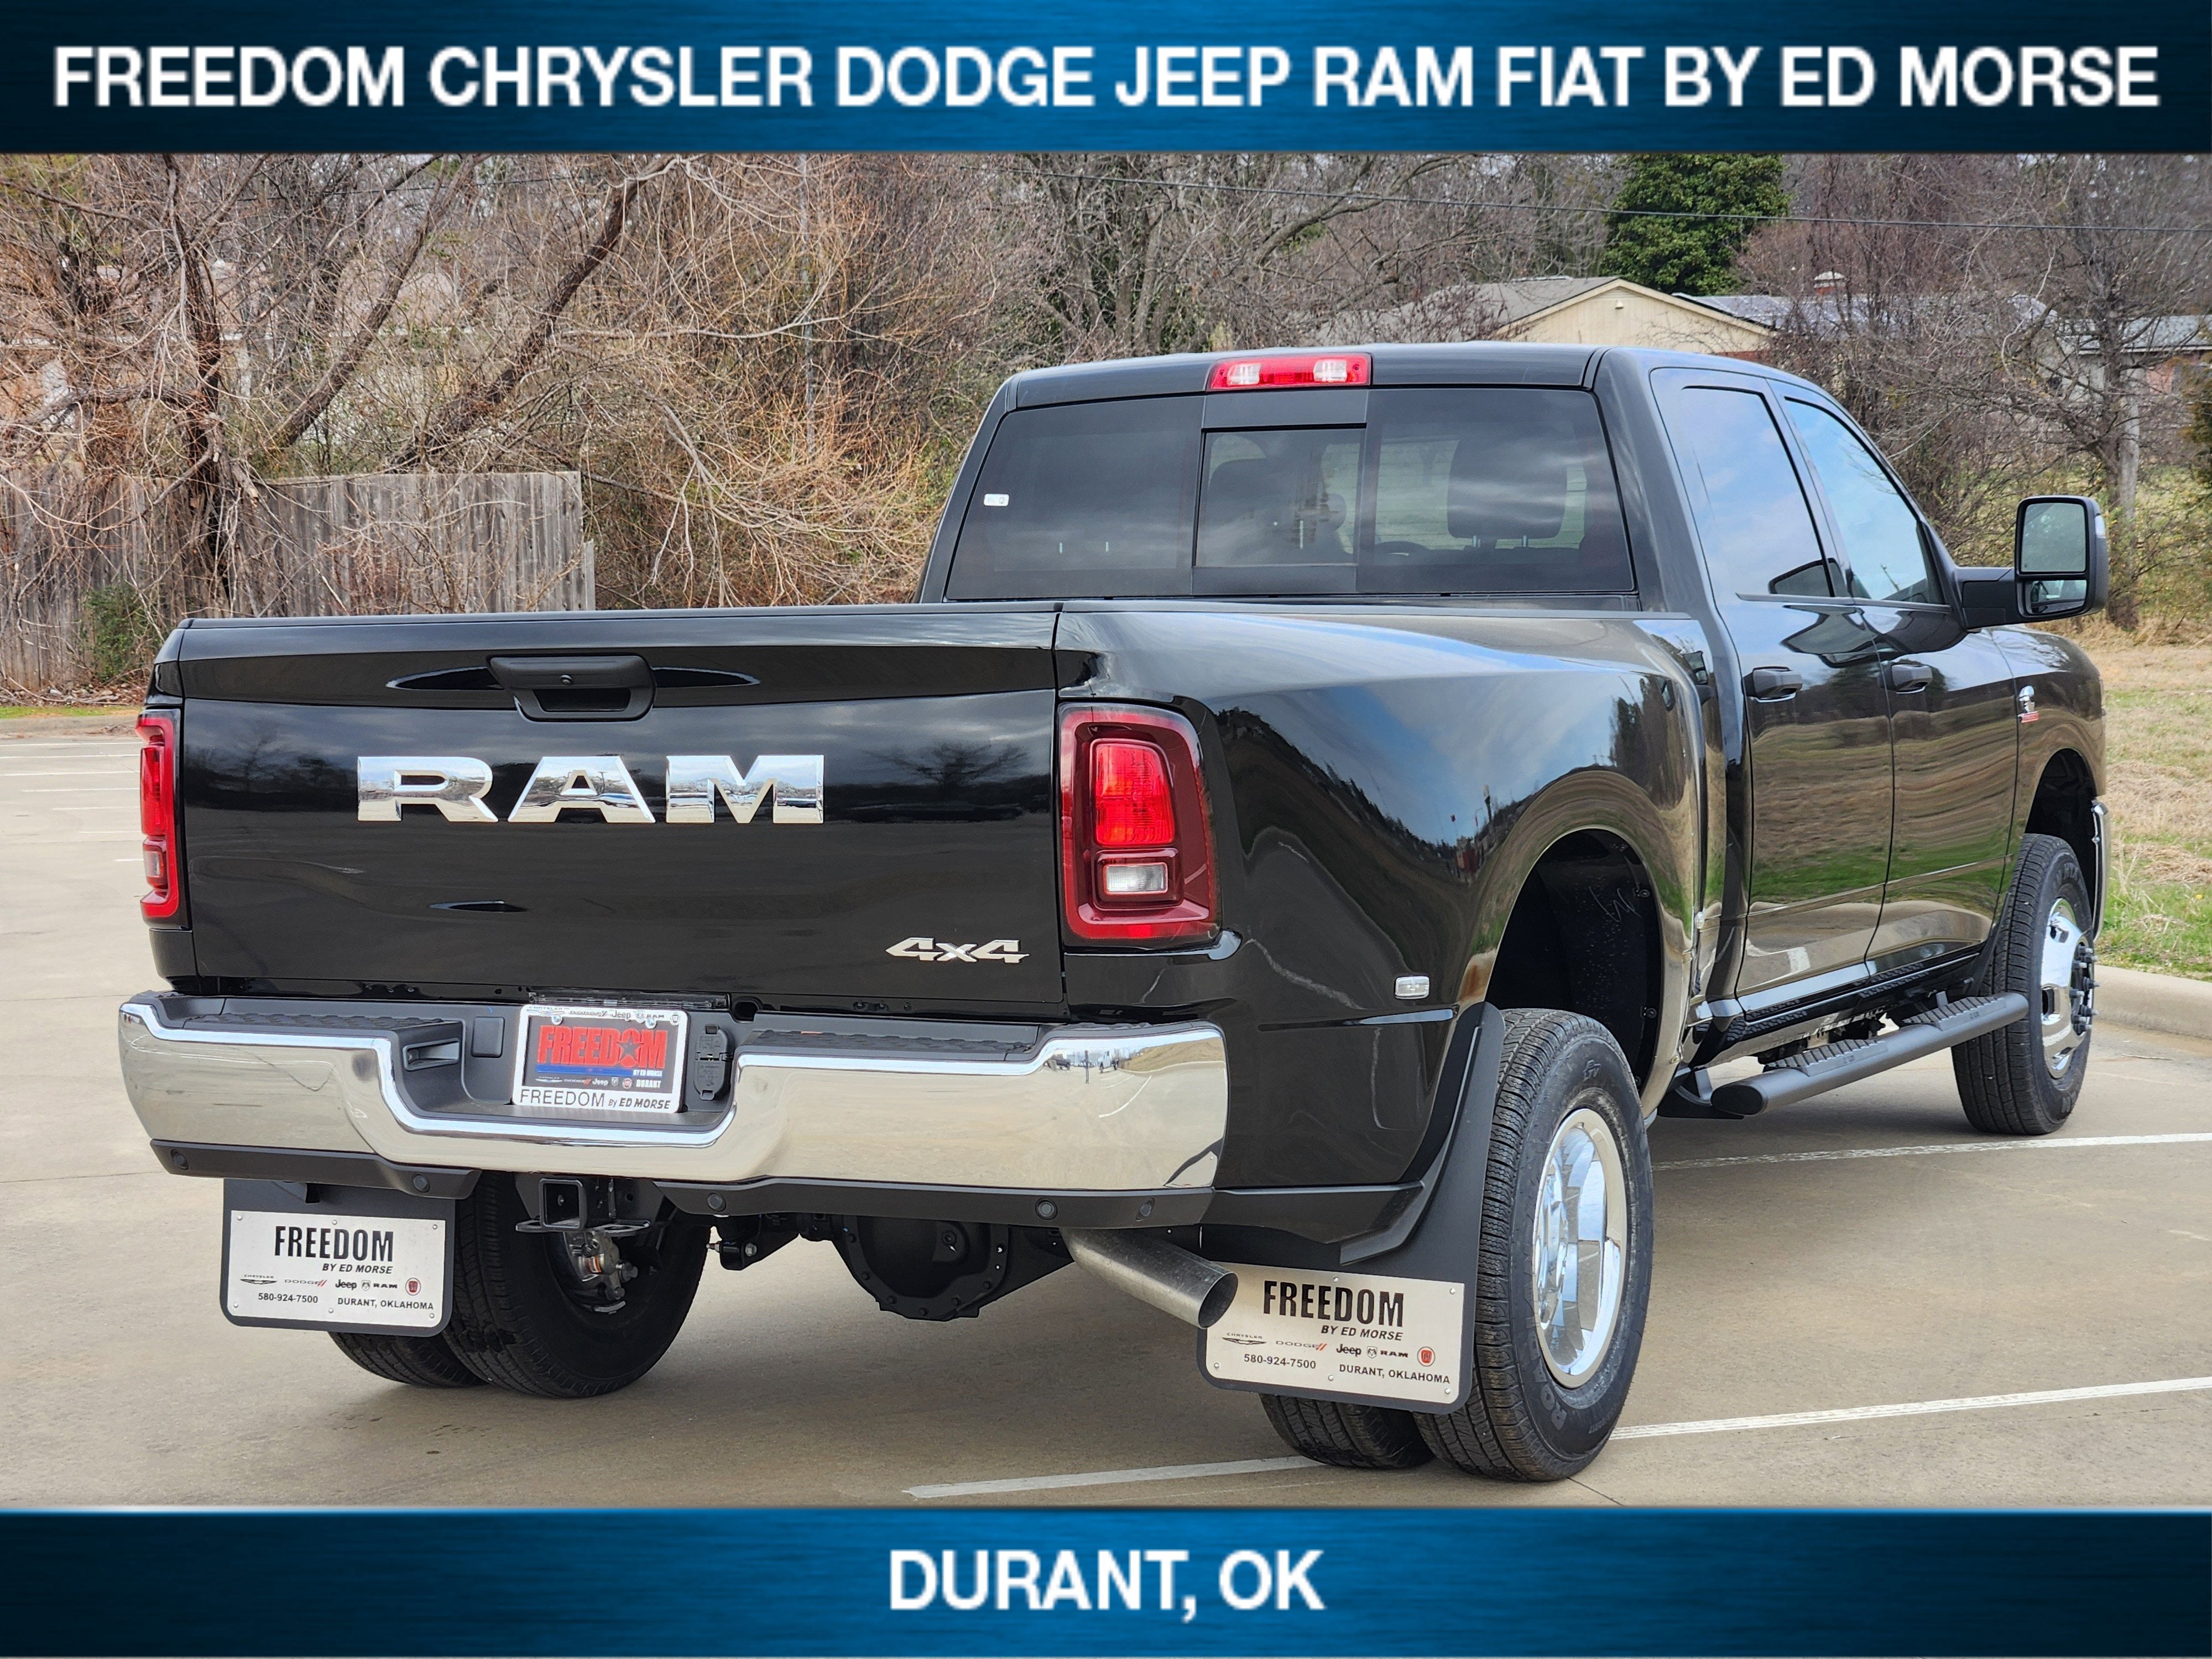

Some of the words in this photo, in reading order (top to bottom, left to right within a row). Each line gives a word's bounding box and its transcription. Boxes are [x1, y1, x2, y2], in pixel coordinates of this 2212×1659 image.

[357, 754, 825, 824] RAM
[885, 937, 1030, 963] 4x4
[612, 1010, 631, 1020] Jeep
[538, 1025, 668, 1068] FREEDOM
[592, 1078, 608, 1086] Jeep
[636, 1079, 661, 1088] DURANT
[520, 1089, 604, 1107] FREEDOM
[619, 1098, 632, 1107] ED
[634, 1098, 671, 1109] MORSE
[274, 1225, 394, 1262] FREEDOM
[322, 1263, 337, 1272] BY
[339, 1264, 353, 1272] ED
[356, 1265, 393, 1274] MORSE
[335, 1279, 357, 1290] Jeep
[258, 1292, 318, 1303] 580-924-7500
[338, 1297, 377, 1308] DURANT,
[380, 1300, 434, 1310] OKLAHOMA
[1263, 1280, 1405, 1328] FREEDOM
[1321, 1325, 1338, 1334] BY
[1340, 1327, 1357, 1337] ED
[1360, 1328, 1403, 1341] MORSE
[1336, 1343, 1361, 1357] Jeep
[1244, 1354, 1317, 1369] 580-924-7500
[1339, 1364, 1384, 1378] DURANT,
[1389, 1370, 1451, 1384] OKLAHOMA
